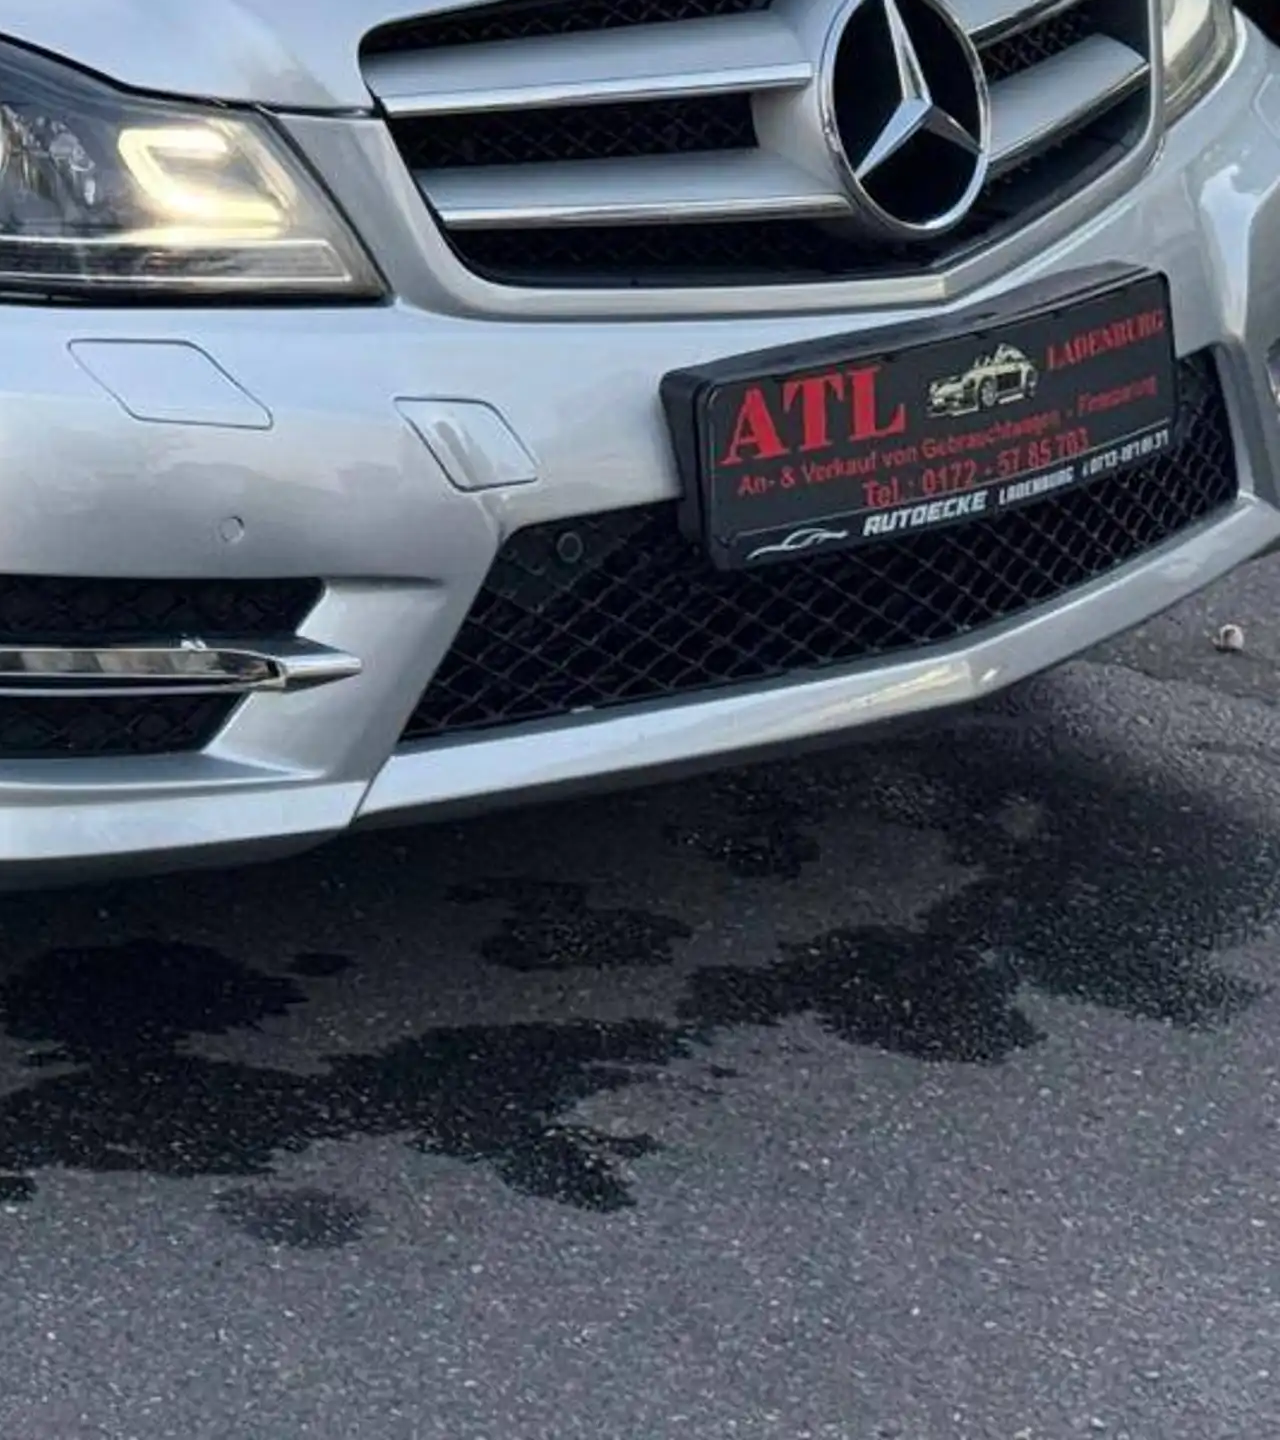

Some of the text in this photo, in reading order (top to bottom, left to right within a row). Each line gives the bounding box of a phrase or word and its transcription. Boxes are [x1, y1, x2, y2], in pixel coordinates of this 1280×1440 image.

[1046, 310, 1165, 371] LADENBURG
[719, 363, 907, 465] ATL
[780, 466, 796, 489] &
[799, 450, 877, 484] Verkauf
[881, 445, 919, 468] von
[921, 458, 978, 496] 0172
[862, 489, 990, 538] AUTOECKE
